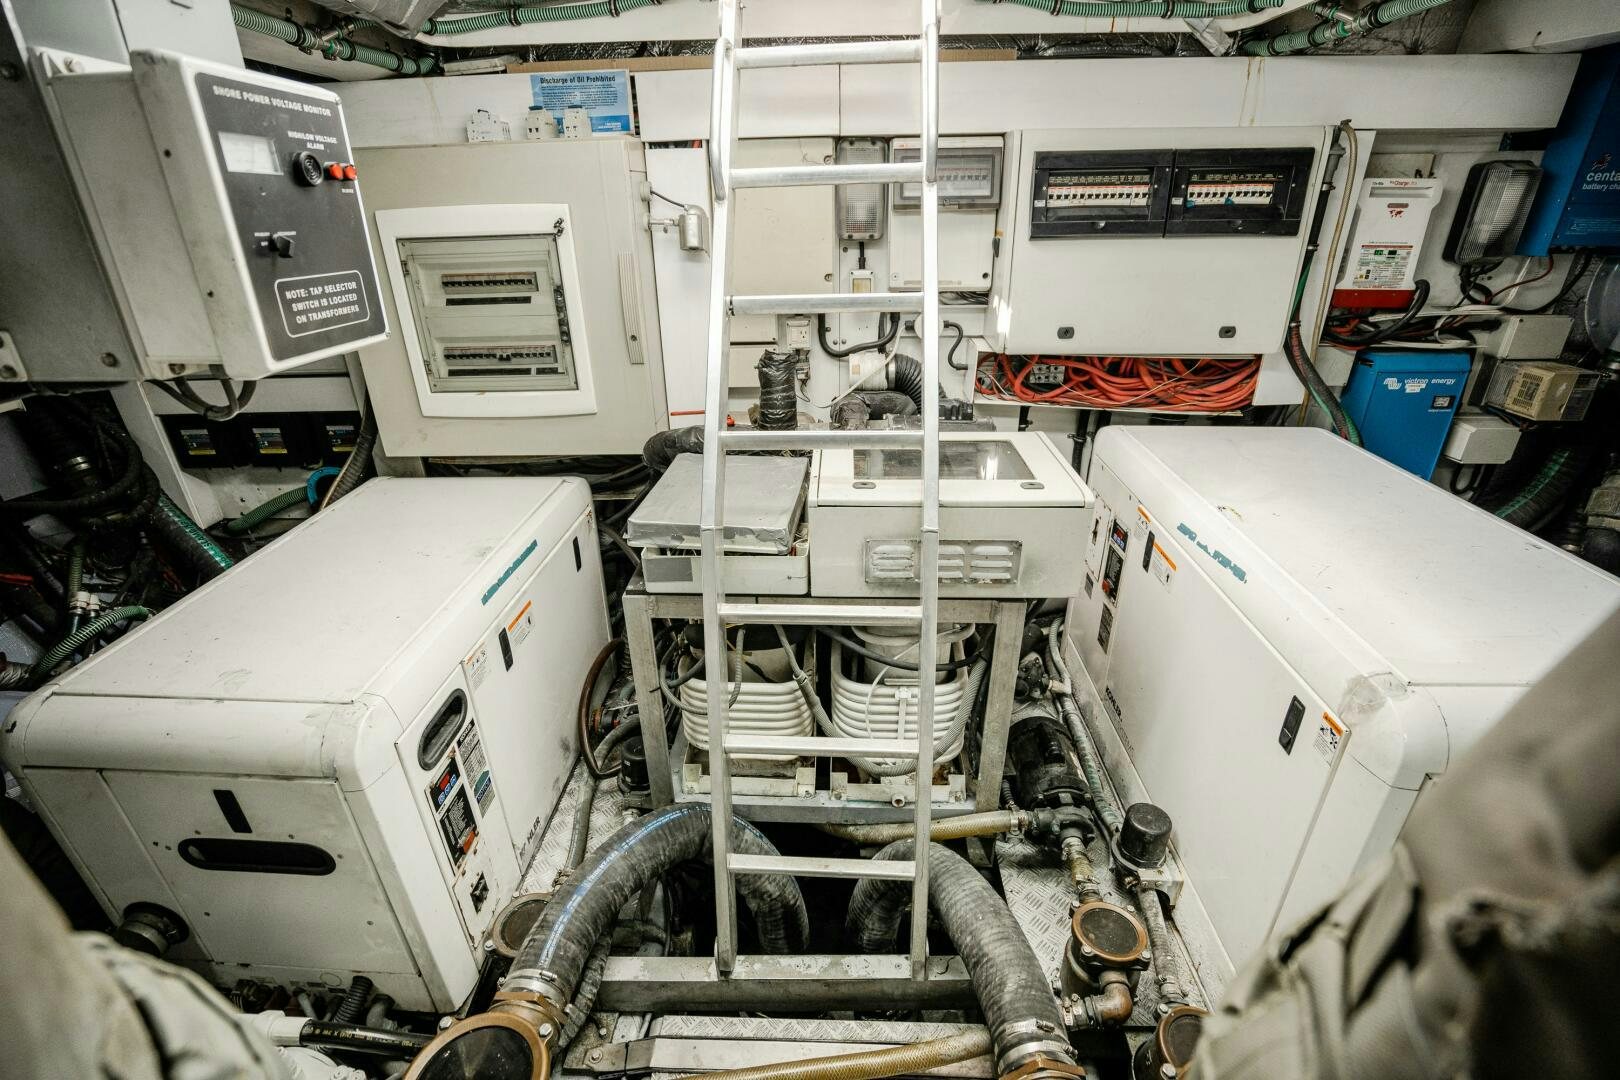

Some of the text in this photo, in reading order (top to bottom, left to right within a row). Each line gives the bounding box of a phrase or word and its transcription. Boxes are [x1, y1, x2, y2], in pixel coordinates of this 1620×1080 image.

[540, 77, 568, 85] Discharge
[570, 76, 576, 84] of
[586, 75, 616, 83] Prohibited
[213, 85, 332, 117] SHORE POWER VOLTAGE MONITOR
[1582, 183, 1608, 192] battery
[285, 281, 357, 300] NOTE: TAP SELECTOR
[291, 293, 358, 312] SWITCH IS LOCATED
[296, 304, 360, 324] ON TRANSFORMERS
